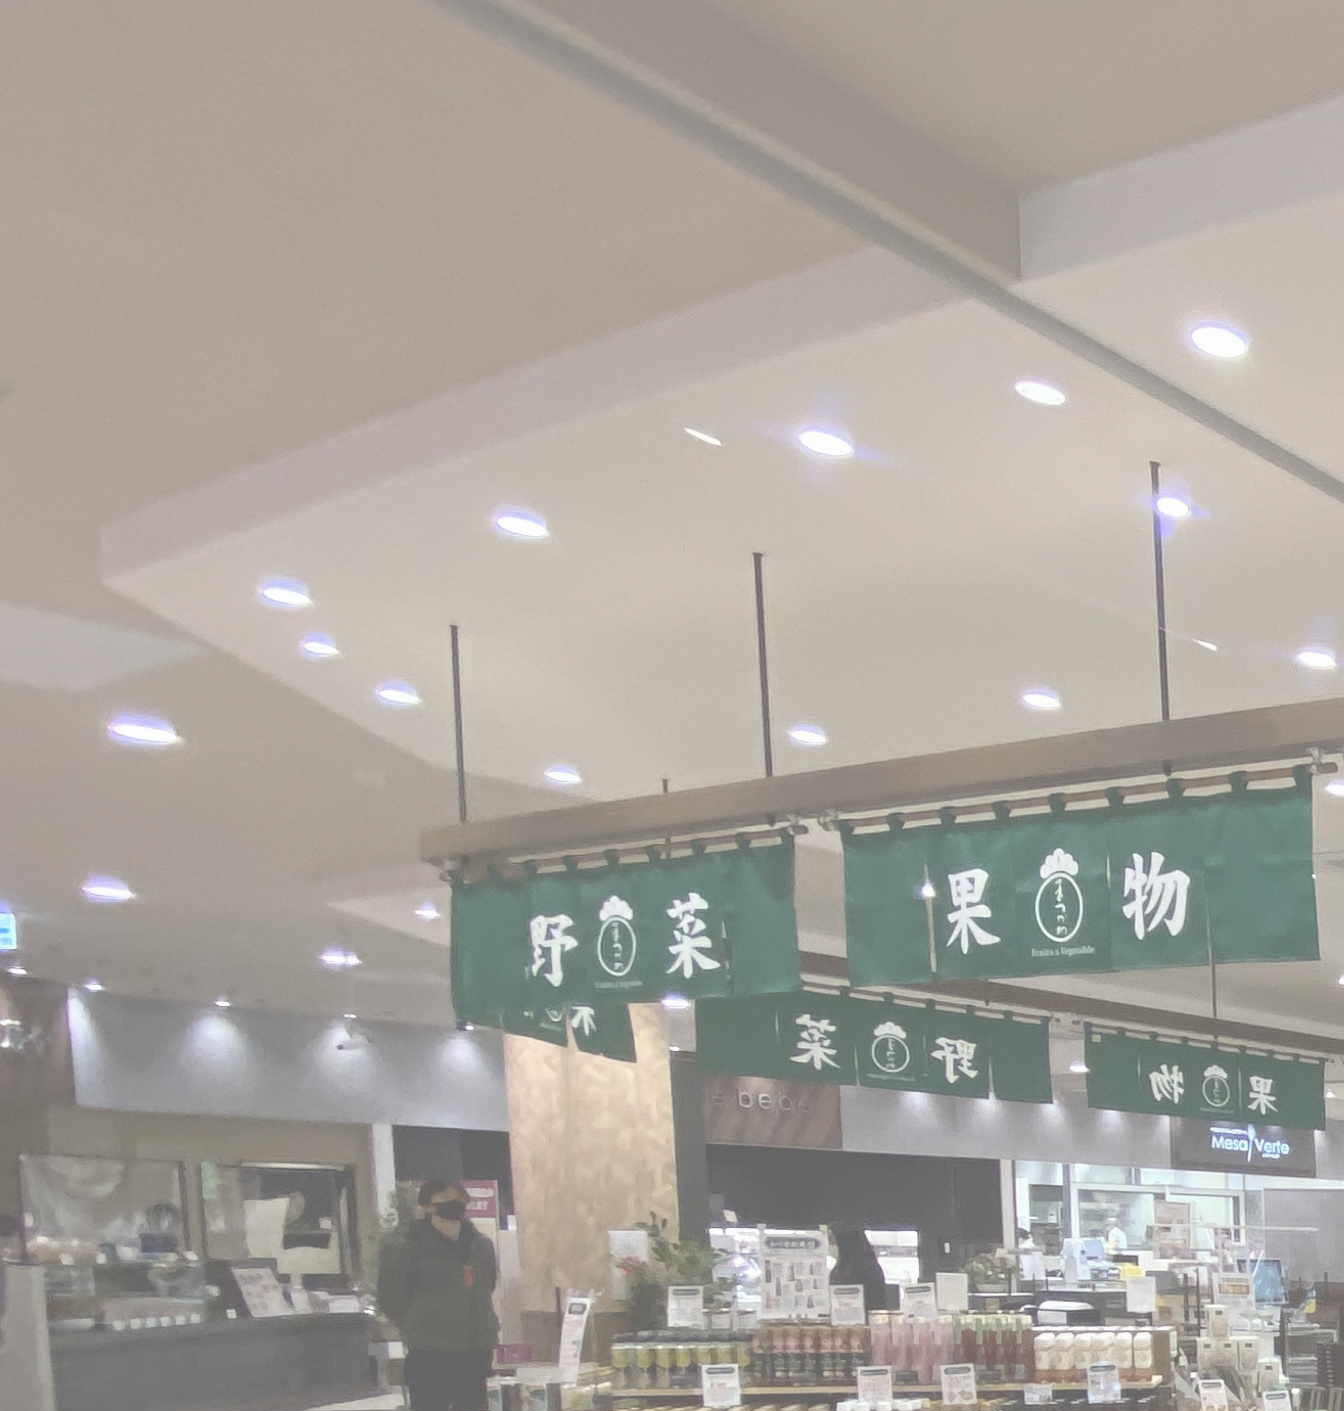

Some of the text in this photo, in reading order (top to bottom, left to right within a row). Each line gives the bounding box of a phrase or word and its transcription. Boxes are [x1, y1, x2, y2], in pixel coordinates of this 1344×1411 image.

[530, 893, 720, 987] 野 菜
[947, 852, 1190, 954] 果 物
[1212, 1135, 1290, 1155] Mesa Verte
